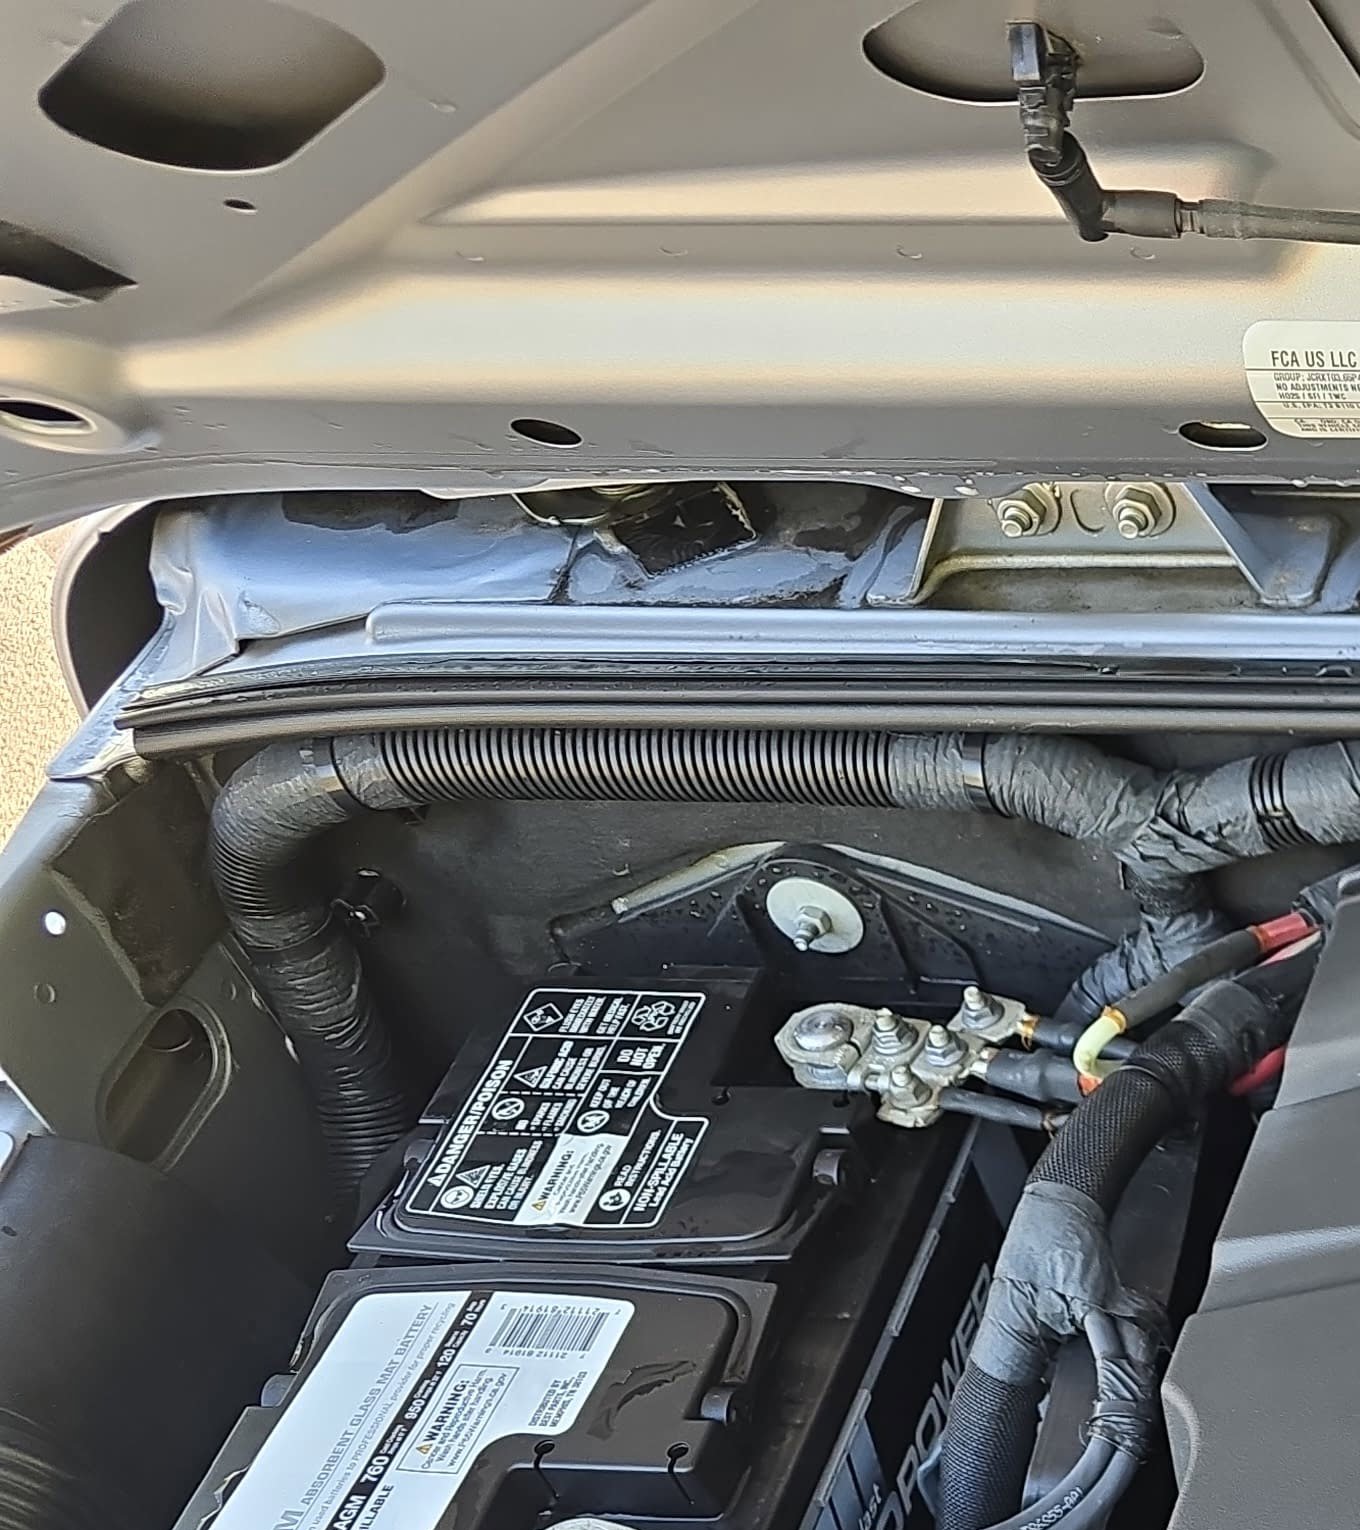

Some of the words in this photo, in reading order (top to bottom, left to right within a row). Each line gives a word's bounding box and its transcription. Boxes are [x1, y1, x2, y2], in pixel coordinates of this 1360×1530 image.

[1271, 350, 1300, 367] FCA
[1305, 351, 1325, 367] US
[1330, 351, 1357, 368] LLC
[1276, 383, 1288, 391] NO
[1290, 383, 1349, 392] ADJUSTMENTS
[616, 1049, 634, 1062] DO
[629, 1046, 649, 1065] NOT
[433, 1060, 513, 1173] DANGER/POISON
[538, 1150, 574, 1200] WARNING:
[612, 1164, 632, 1186] READ
[633, 1132, 684, 1211] NON-SPILLABLE
[459, 1312, 480, 1326] 70
[435, 1348, 458, 1366] 120
[298, 1430, 356, 1505] ABSORBENT
[347, 1388, 382, 1426] GLASS
[374, 1358, 401, 1383] MAT
[392, 1304, 434, 1355] BATTERY
[402, 1399, 427, 1419] 950
[422, 1380, 470, 1441] WARNING:
[358, 1455, 392, 1482] 760
